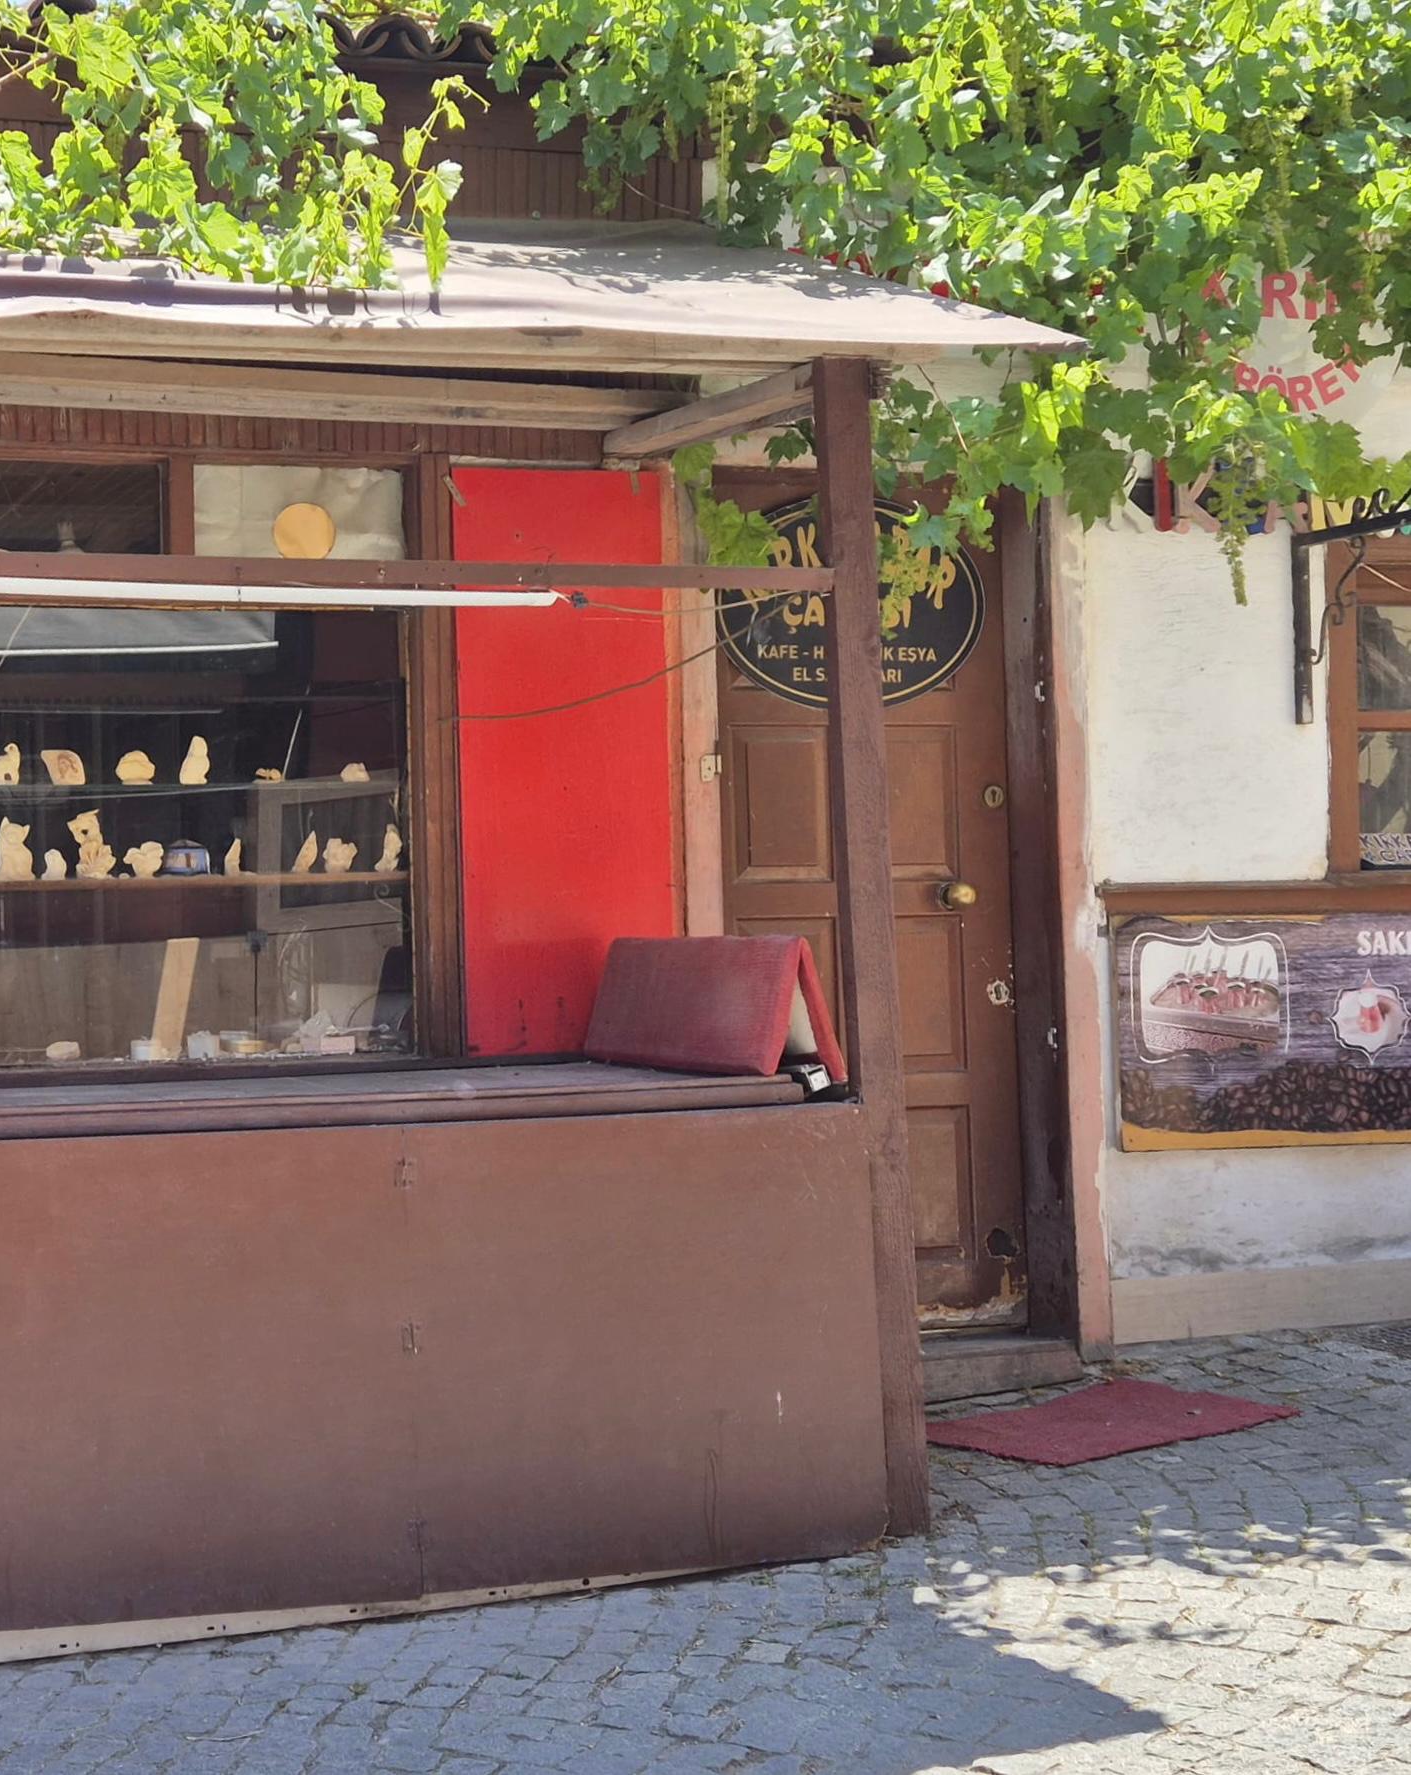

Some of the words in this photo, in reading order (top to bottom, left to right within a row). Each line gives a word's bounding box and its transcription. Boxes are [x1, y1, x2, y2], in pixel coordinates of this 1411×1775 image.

[757, 644, 799, 660] KAFE
[898, 646, 937, 664] EŞYA
[792, 667, 812, 682] EL
